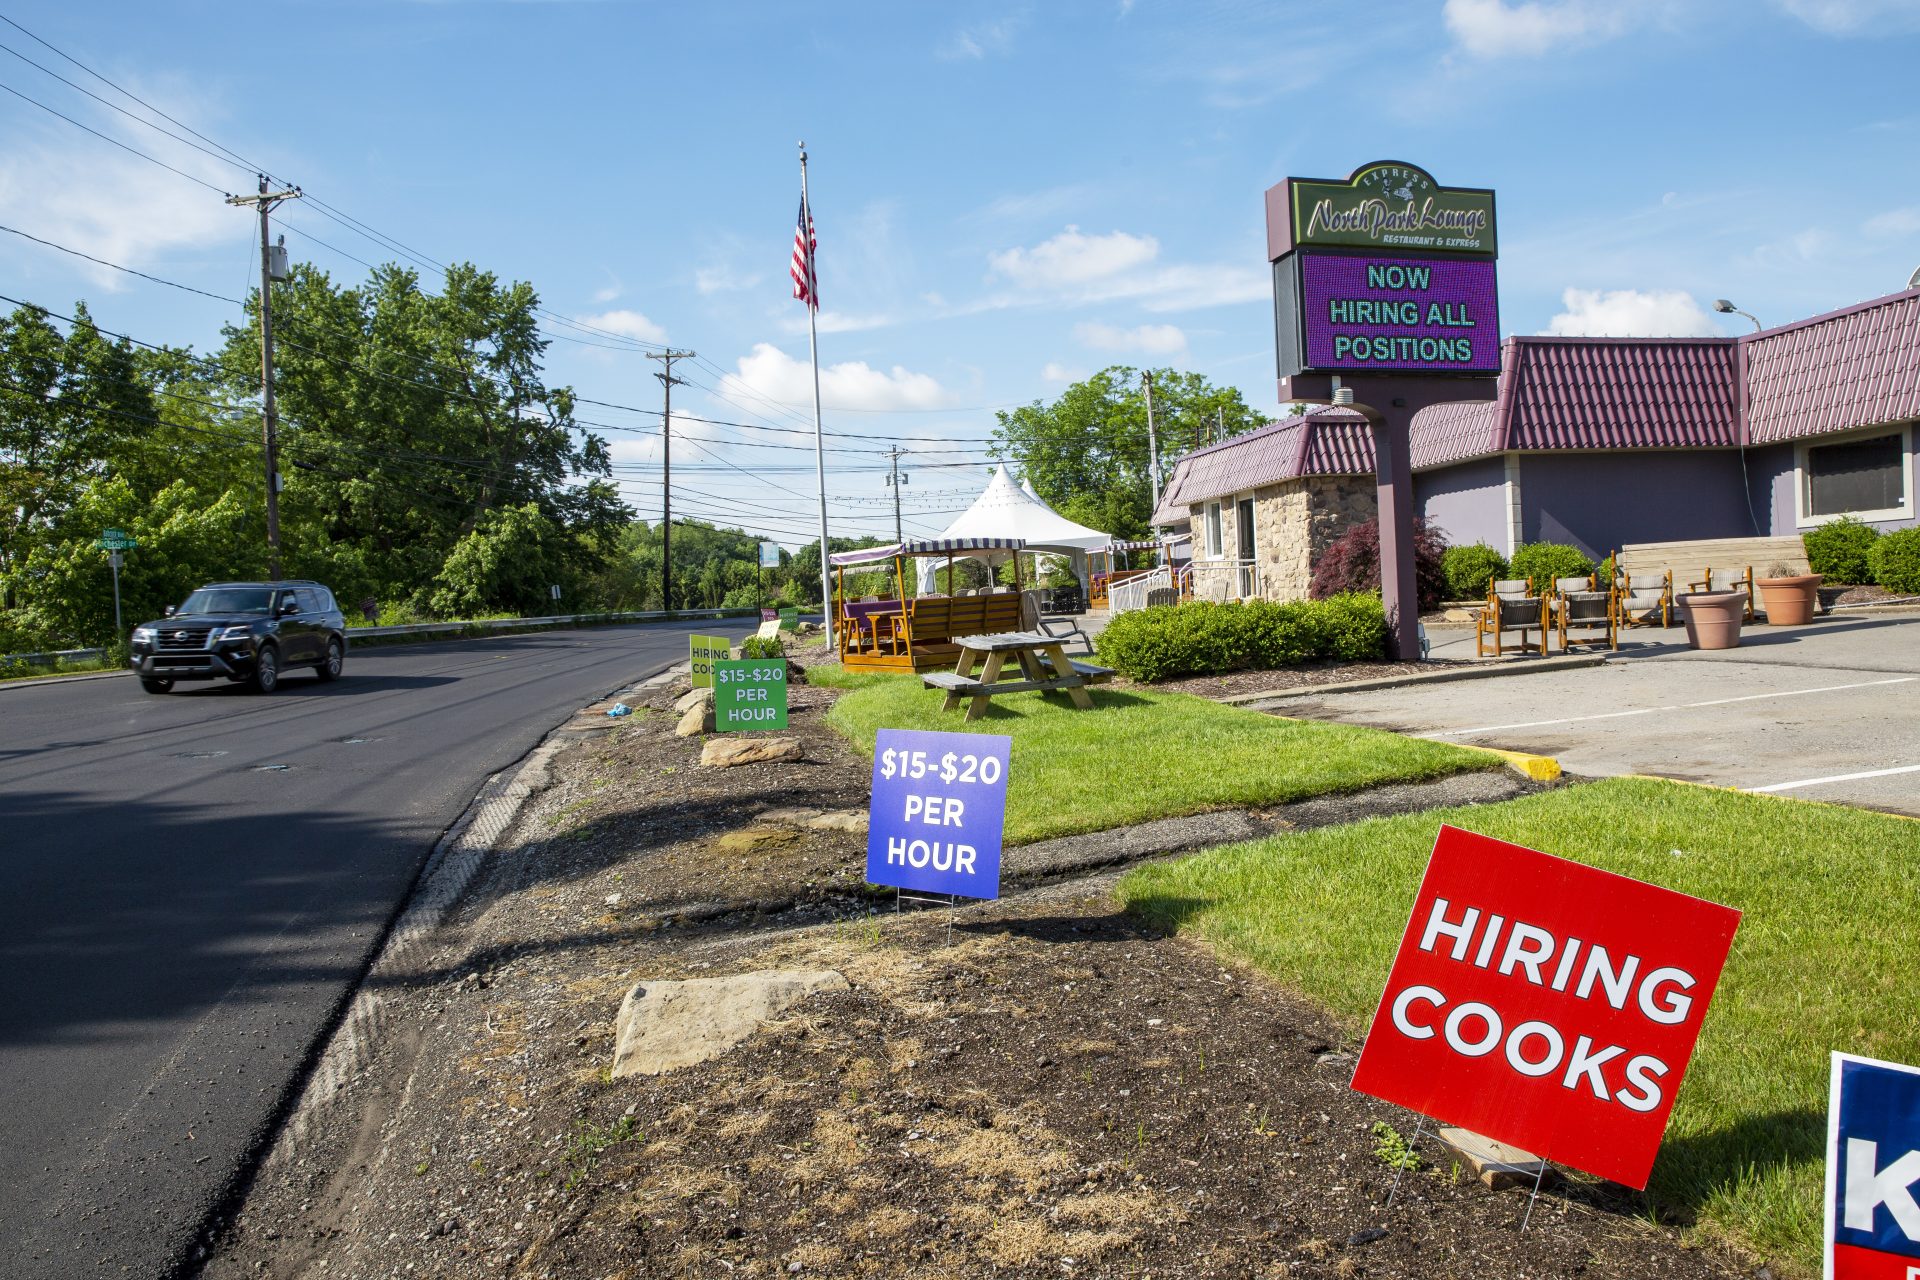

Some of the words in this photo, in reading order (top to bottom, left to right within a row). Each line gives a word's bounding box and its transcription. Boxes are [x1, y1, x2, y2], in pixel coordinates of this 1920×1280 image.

[1363, 168, 1428, 189] EXPRESS
[1307, 199, 1369, 237] North
[1368, 199, 1419, 239] Park
[1420, 197, 1486, 238] Lounge
[1383, 234, 1434, 245] RESTAURANT
[1436, 238, 1443, 246] &
[1446, 238, 1480, 248] EXPRESS
[1368, 266, 1430, 290] NOW
[1330, 300, 1419, 325] HIRING
[1426, 303, 1475, 326] ALL
[1335, 336, 1472, 361] POSITIONS
[693, 648, 729, 660] HIRING
[719, 668, 783, 683] $15-$20
[736, 688, 767, 702] PER
[728, 707, 776, 722] HOUR
[880, 747, 1001, 785] $15-$20
[904, 794, 965, 827] PER
[887, 837, 977, 875] HOUR
[1418, 896, 1698, 1026] HIRING
[1391, 984, 1671, 1113] COOKS
